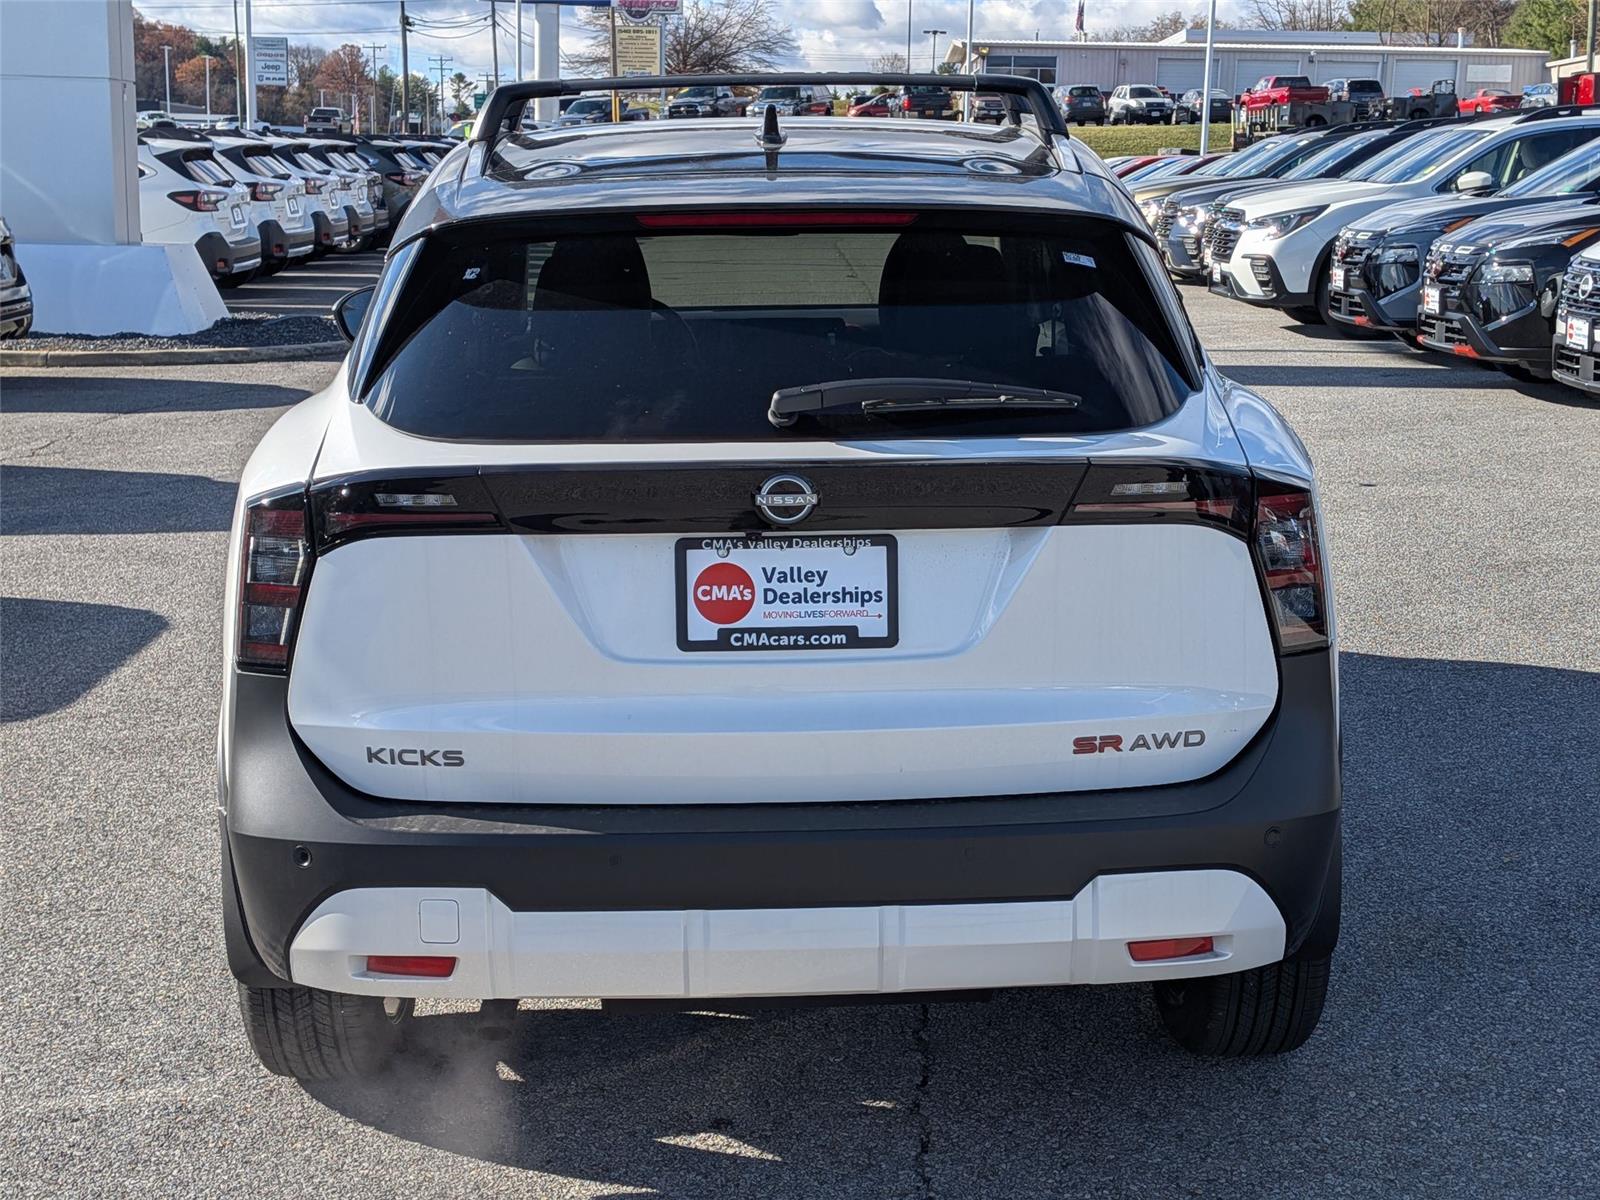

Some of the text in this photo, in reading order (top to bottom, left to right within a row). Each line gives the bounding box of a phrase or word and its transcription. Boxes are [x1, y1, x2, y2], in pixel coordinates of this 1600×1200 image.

[261, 62, 280, 71] Jeep
[757, 495, 817, 505] NISSAN
[701, 537, 872, 551] CMA's Valley Dealerships
[761, 566, 829, 587] Valley
[696, 585, 752, 601] CMA's
[763, 586, 884, 608] Dealerships
[730, 632, 847, 647] CMAcars.com
[1072, 729, 1206, 755] SR AWD
[366, 746, 465, 767] KICKS
